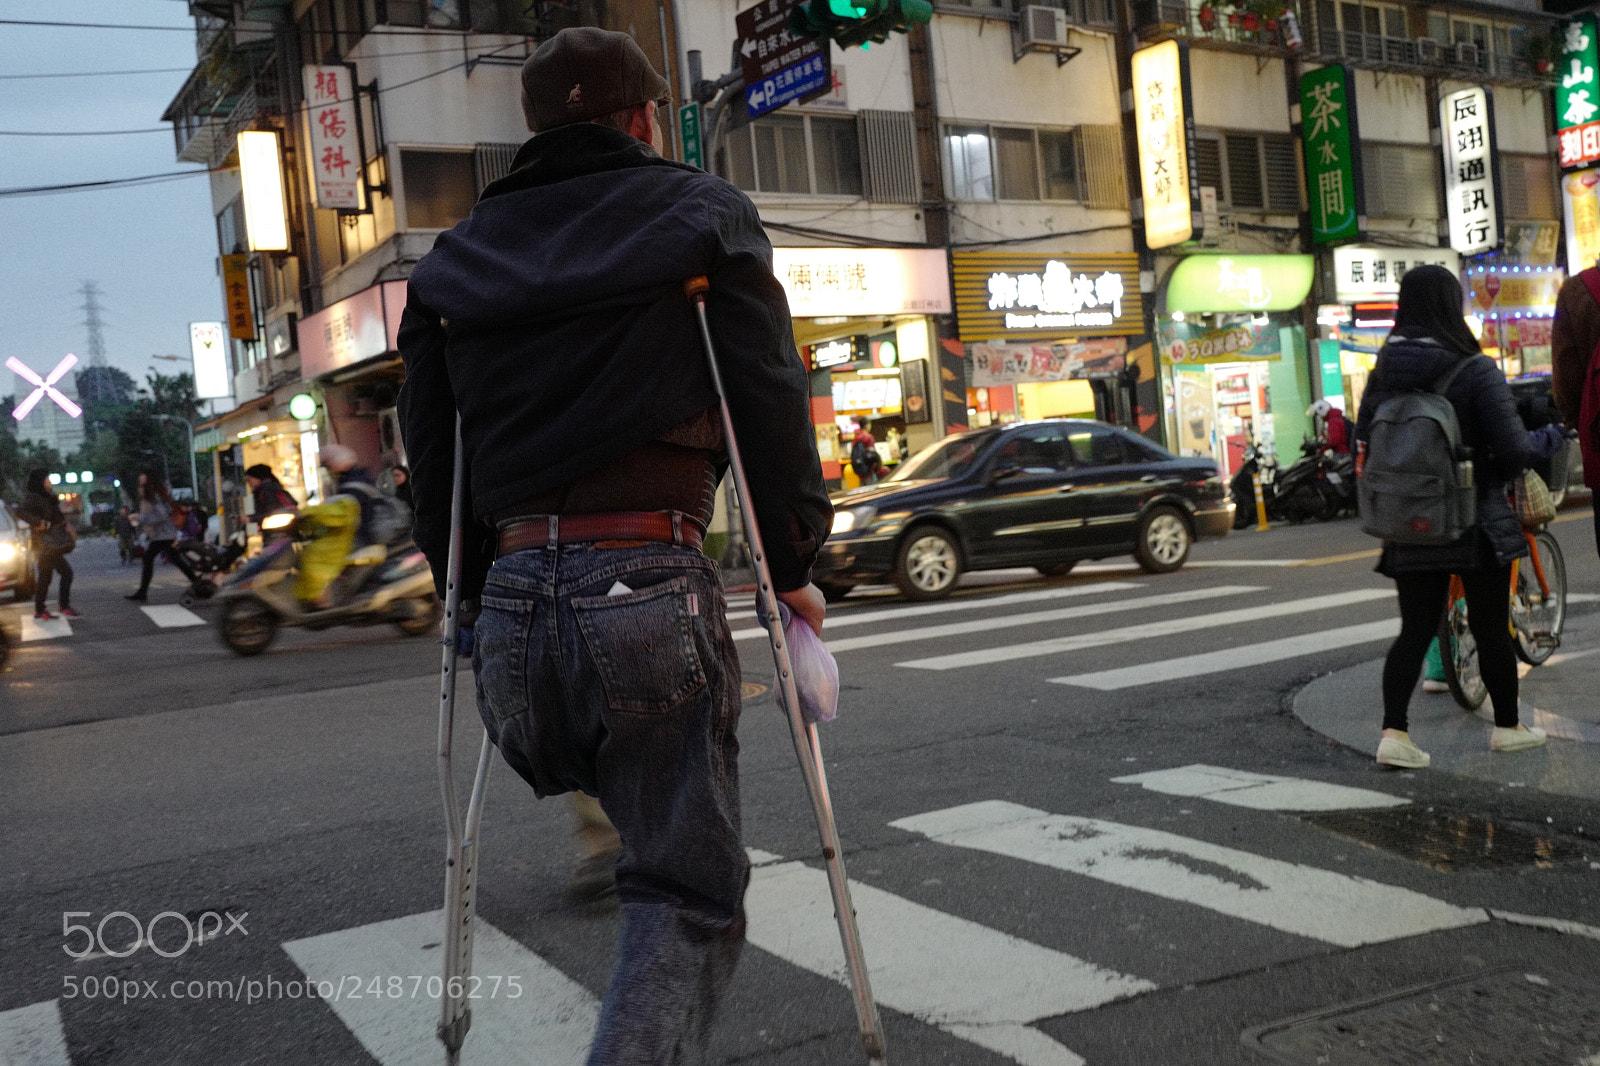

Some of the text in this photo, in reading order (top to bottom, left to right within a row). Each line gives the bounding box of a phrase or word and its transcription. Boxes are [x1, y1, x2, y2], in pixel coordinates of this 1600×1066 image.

[1306, 81, 1345, 233] 茶水間
[1453, 94, 1490, 244] 辰翊通訊行
[1351, 261, 1446, 282] 辰翊通
